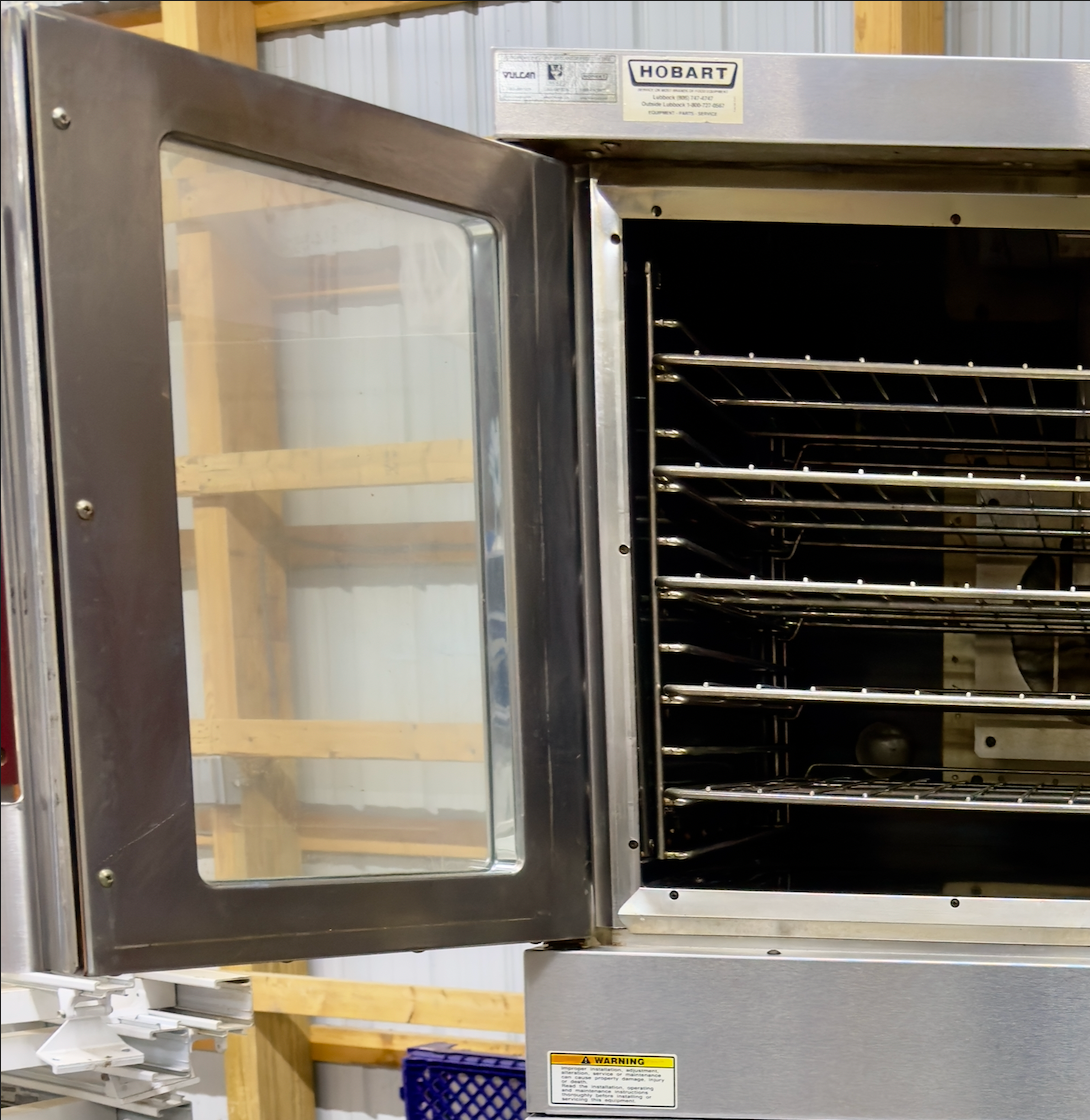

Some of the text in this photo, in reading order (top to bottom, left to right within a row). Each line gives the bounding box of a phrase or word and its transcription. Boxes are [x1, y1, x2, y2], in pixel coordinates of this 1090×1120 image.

[502, 71, 536, 79] VULCAN
[640, 65, 727, 79] HOBART
[594, 1057, 644, 1065] WARNING
